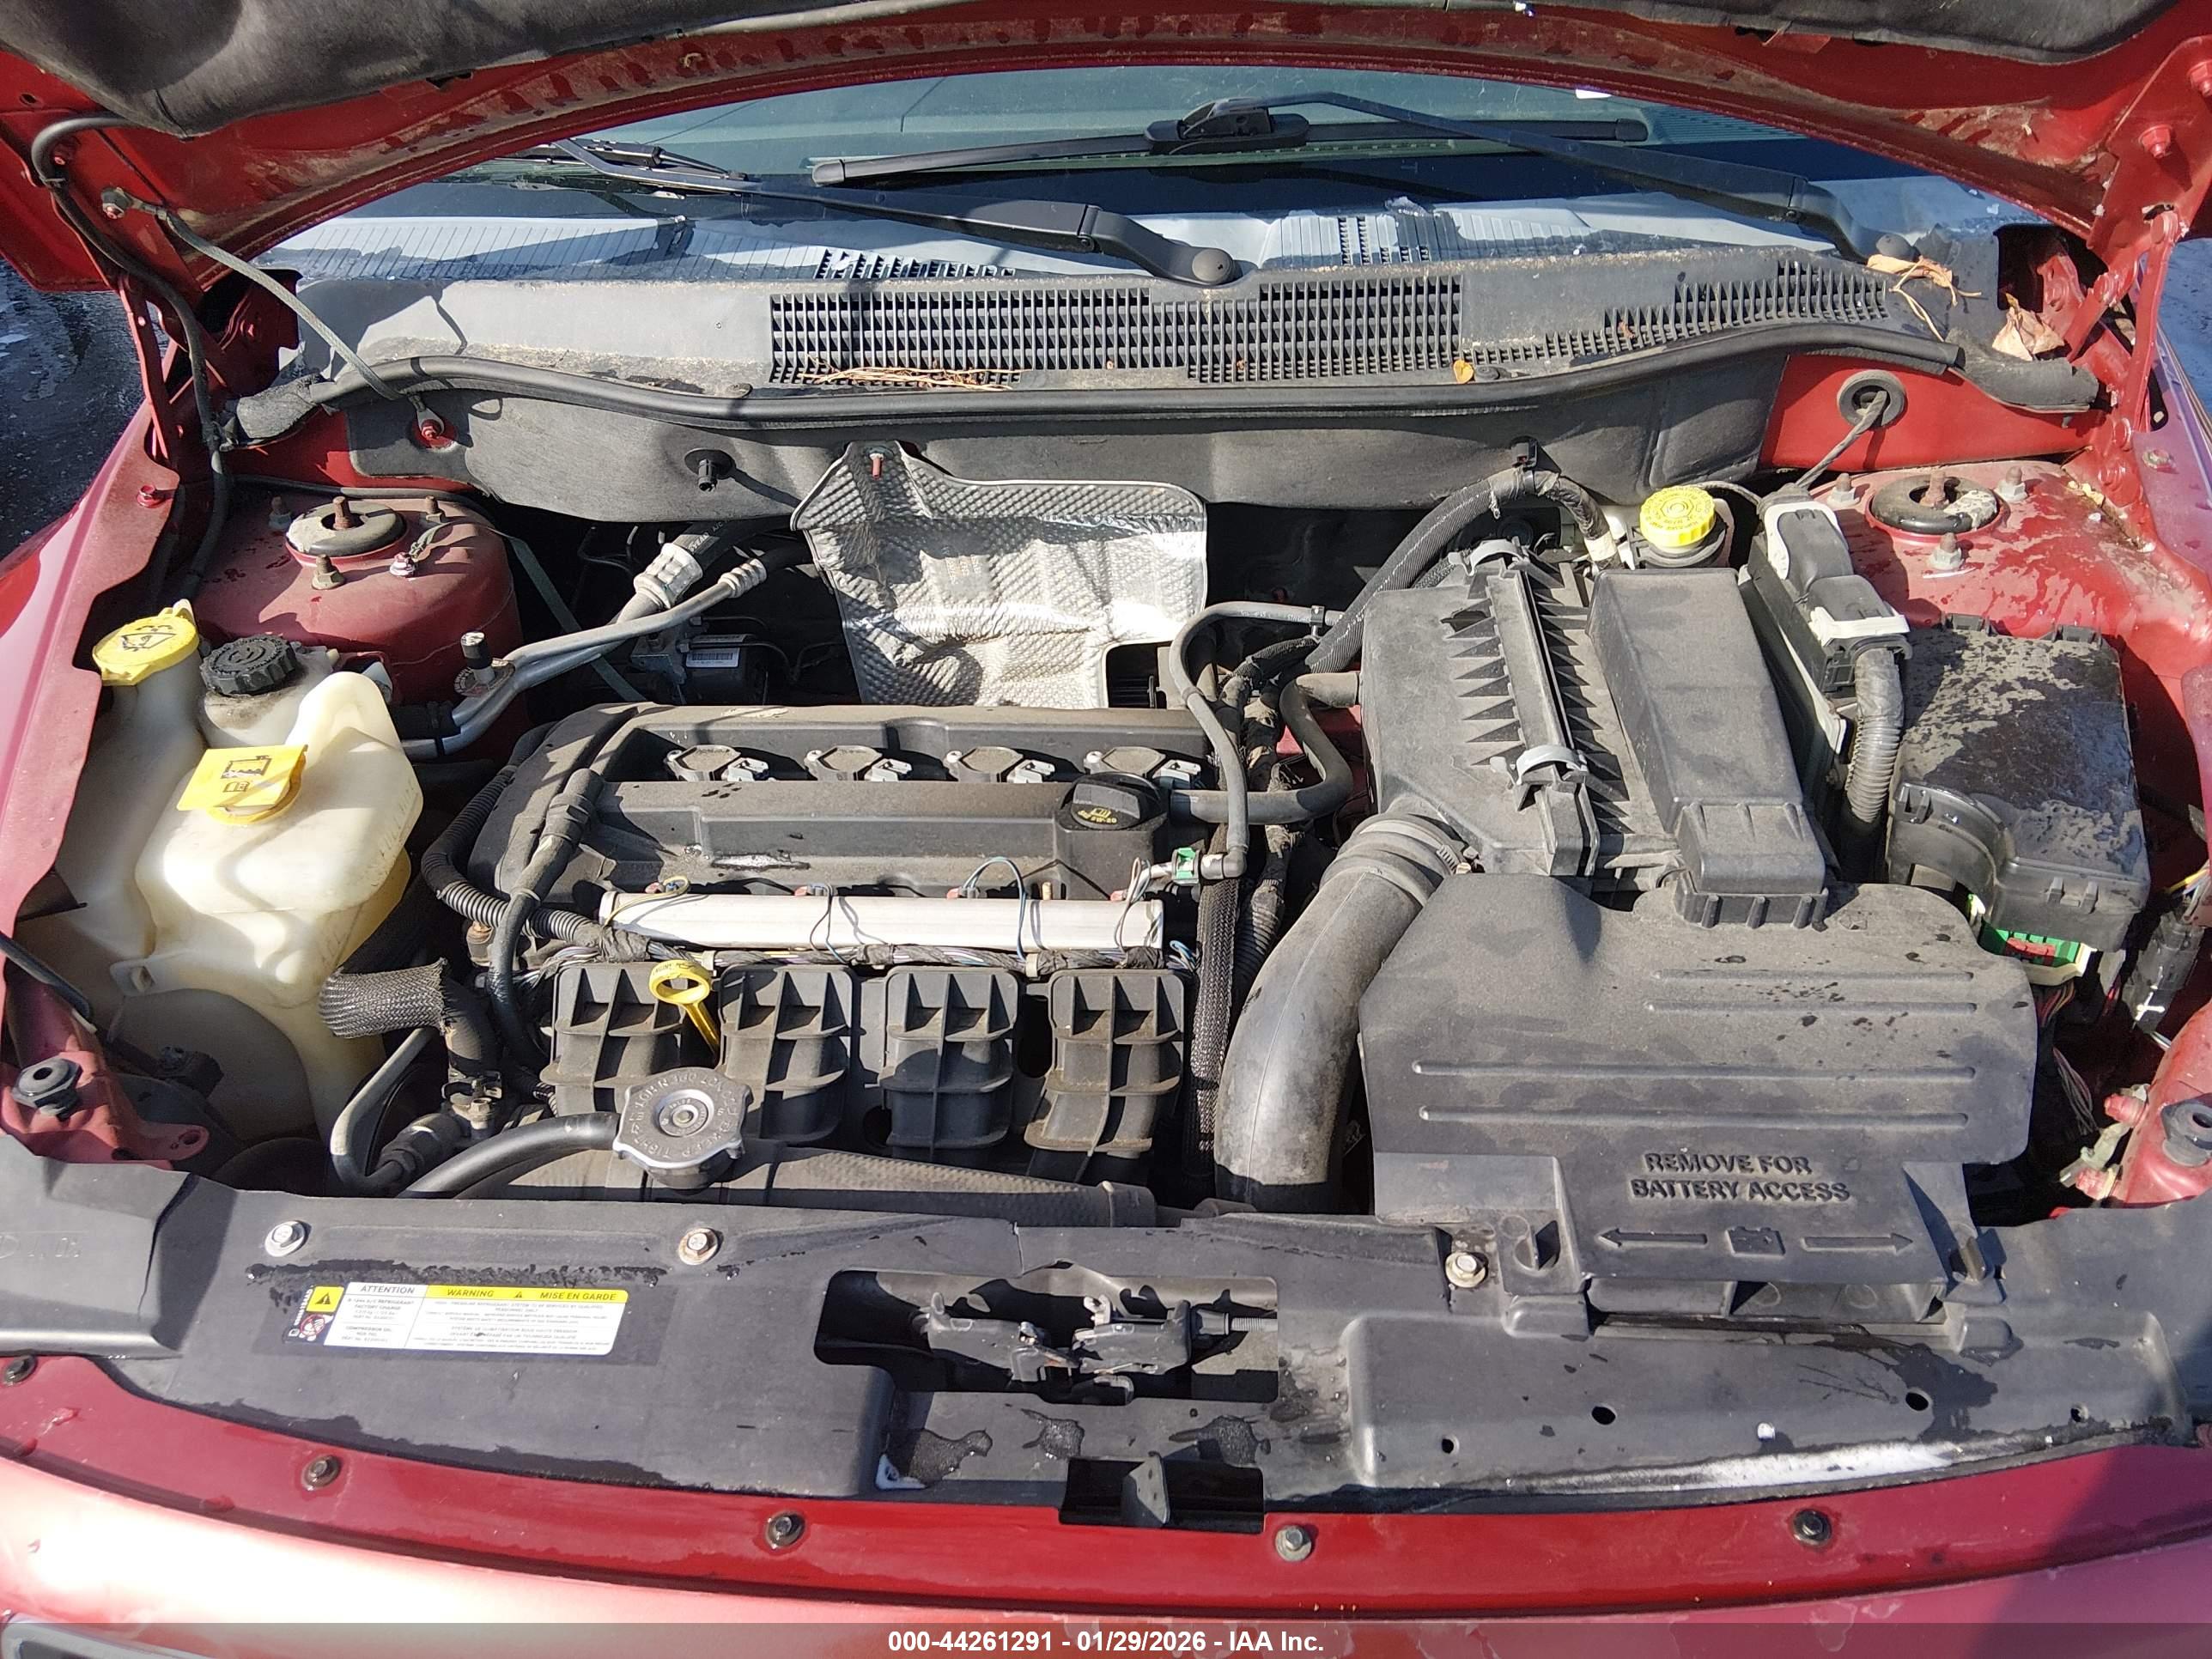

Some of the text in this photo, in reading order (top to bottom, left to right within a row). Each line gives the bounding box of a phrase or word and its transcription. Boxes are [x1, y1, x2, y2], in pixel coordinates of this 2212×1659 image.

[1645, 1152, 1813, 1175] REMOVE FOR
[1632, 1179, 1850, 1202] BATTERY ACCESS
[360, 1284, 416, 1295] ATTENTION
[447, 1288, 495, 1297] WARNING
[539, 1291, 617, 1301] MISE EN GARDE
